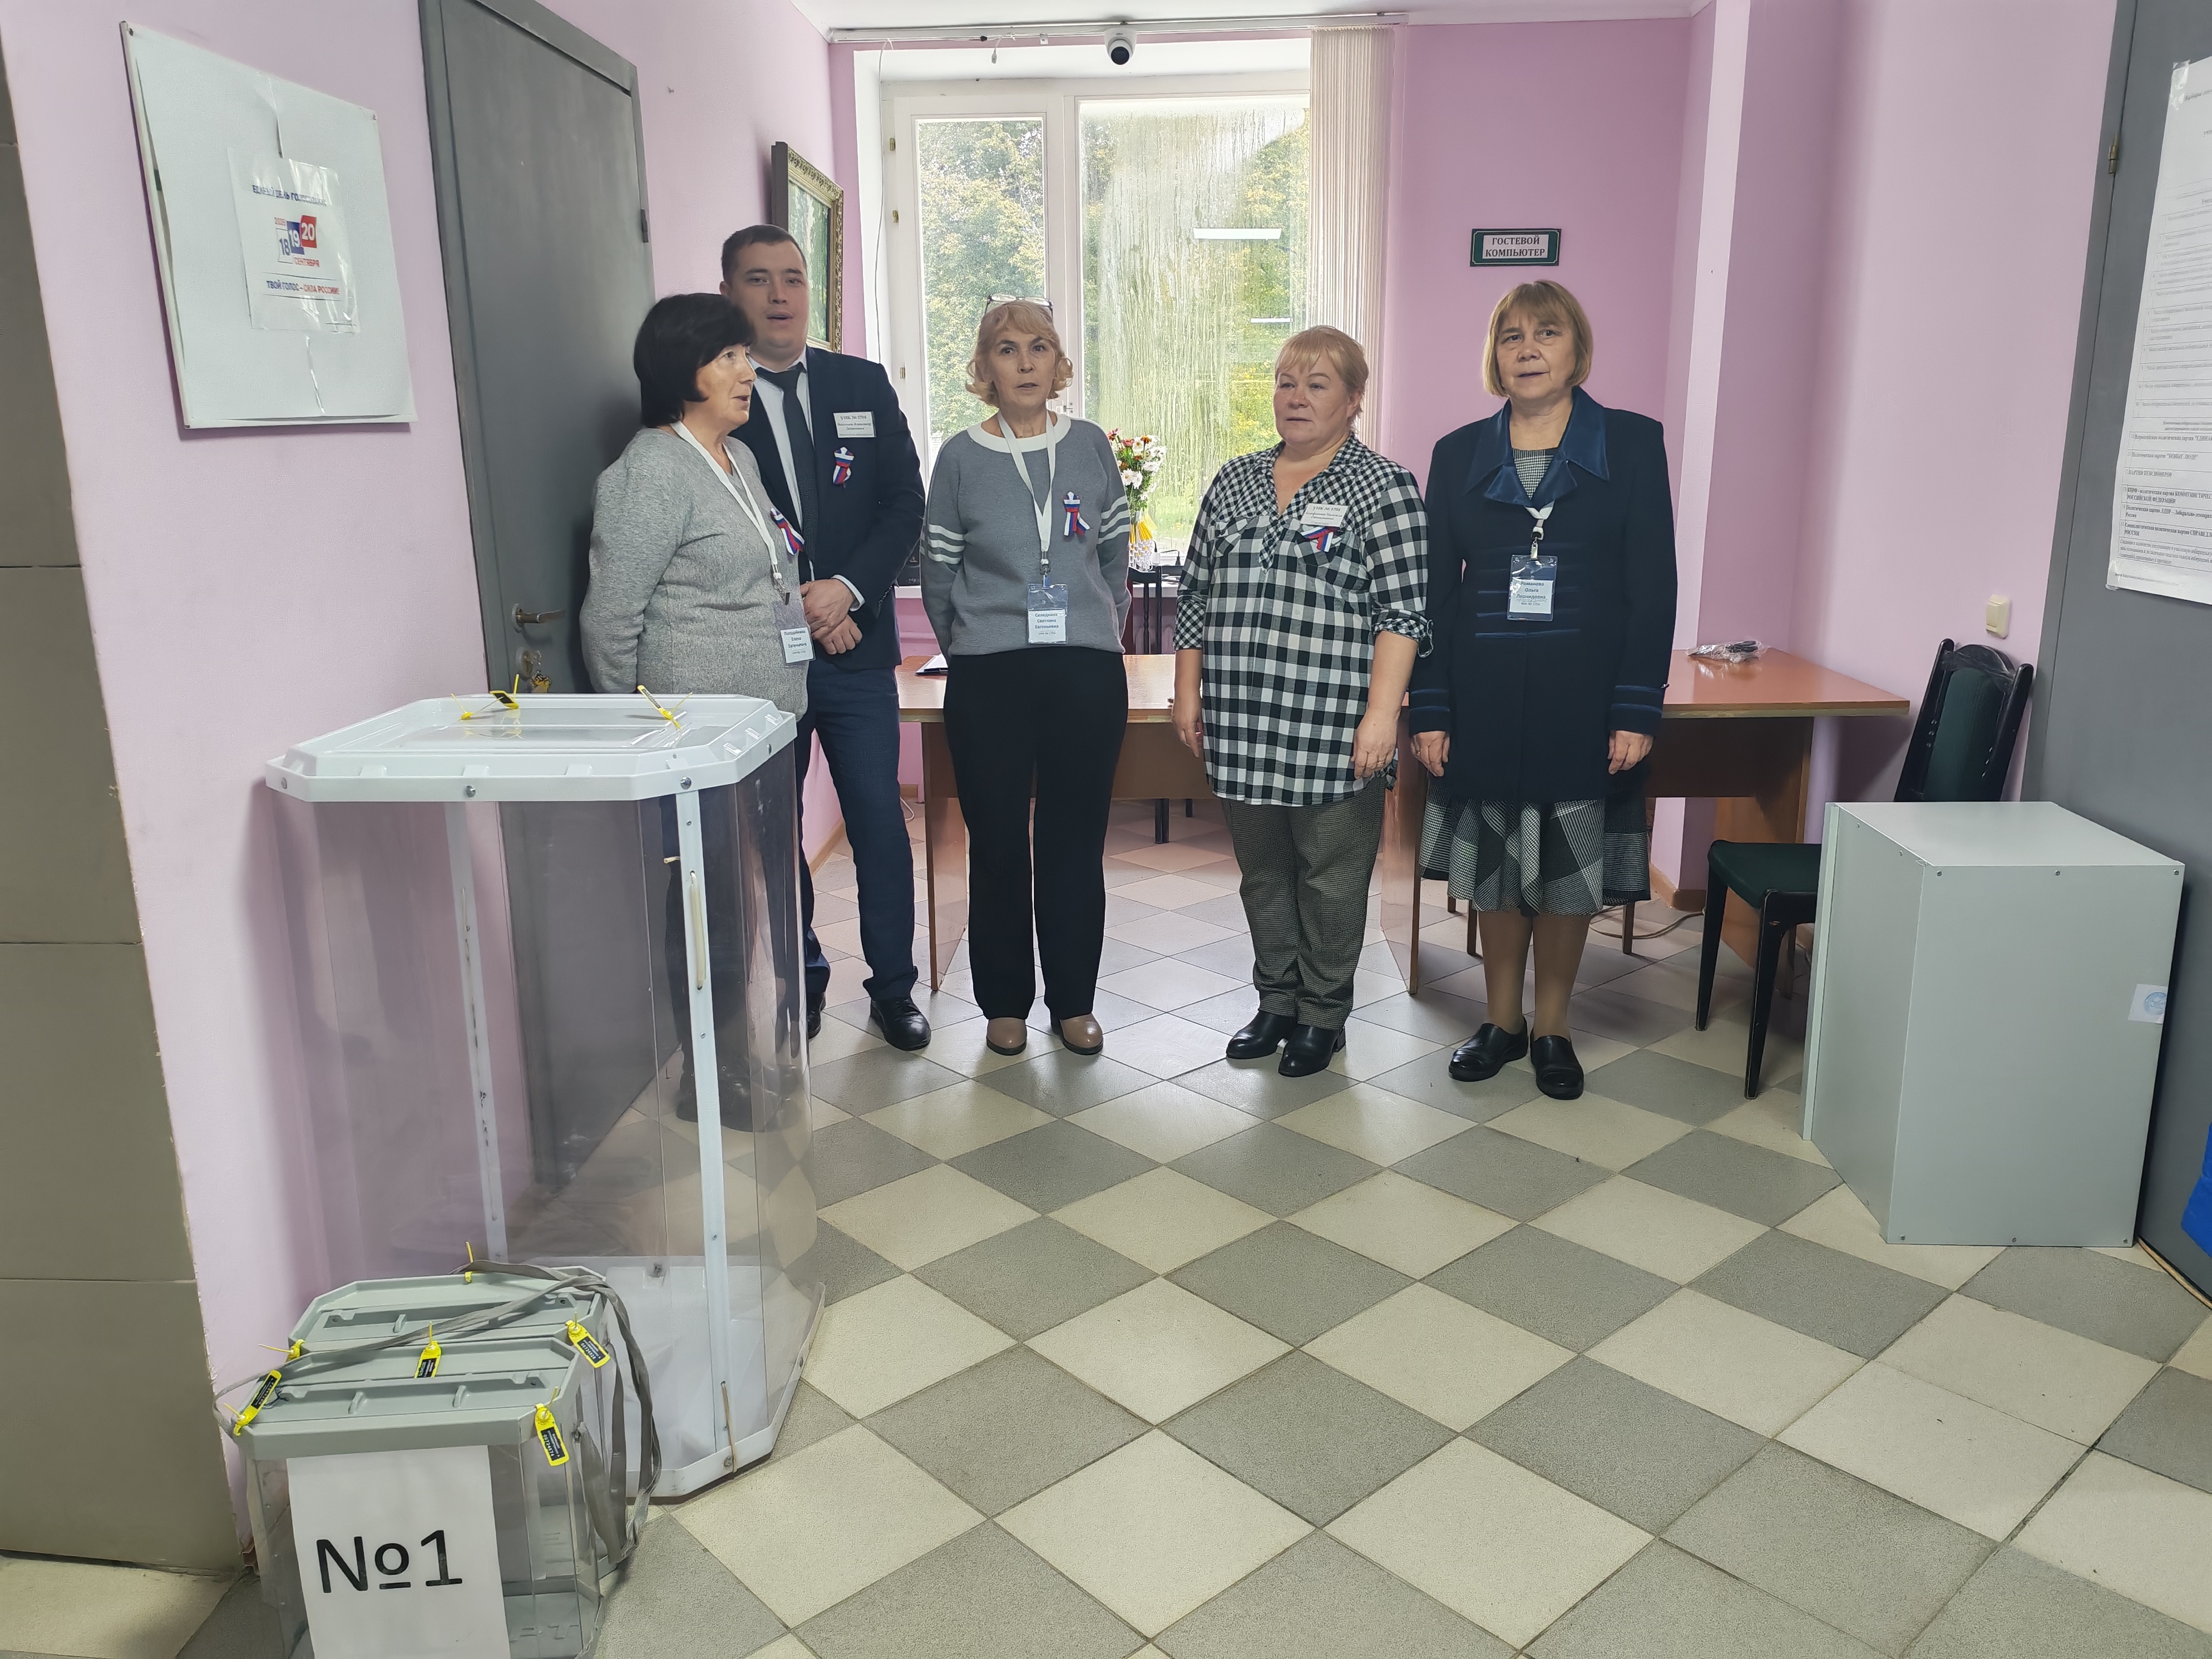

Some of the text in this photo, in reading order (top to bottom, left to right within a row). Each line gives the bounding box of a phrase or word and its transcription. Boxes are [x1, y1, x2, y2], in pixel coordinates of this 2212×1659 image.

[279, 222, 315, 255] 18 19 20
[1492, 235, 1540, 245] ГОСТЕВОЙ
[316, 1530, 463, 1594] №1
